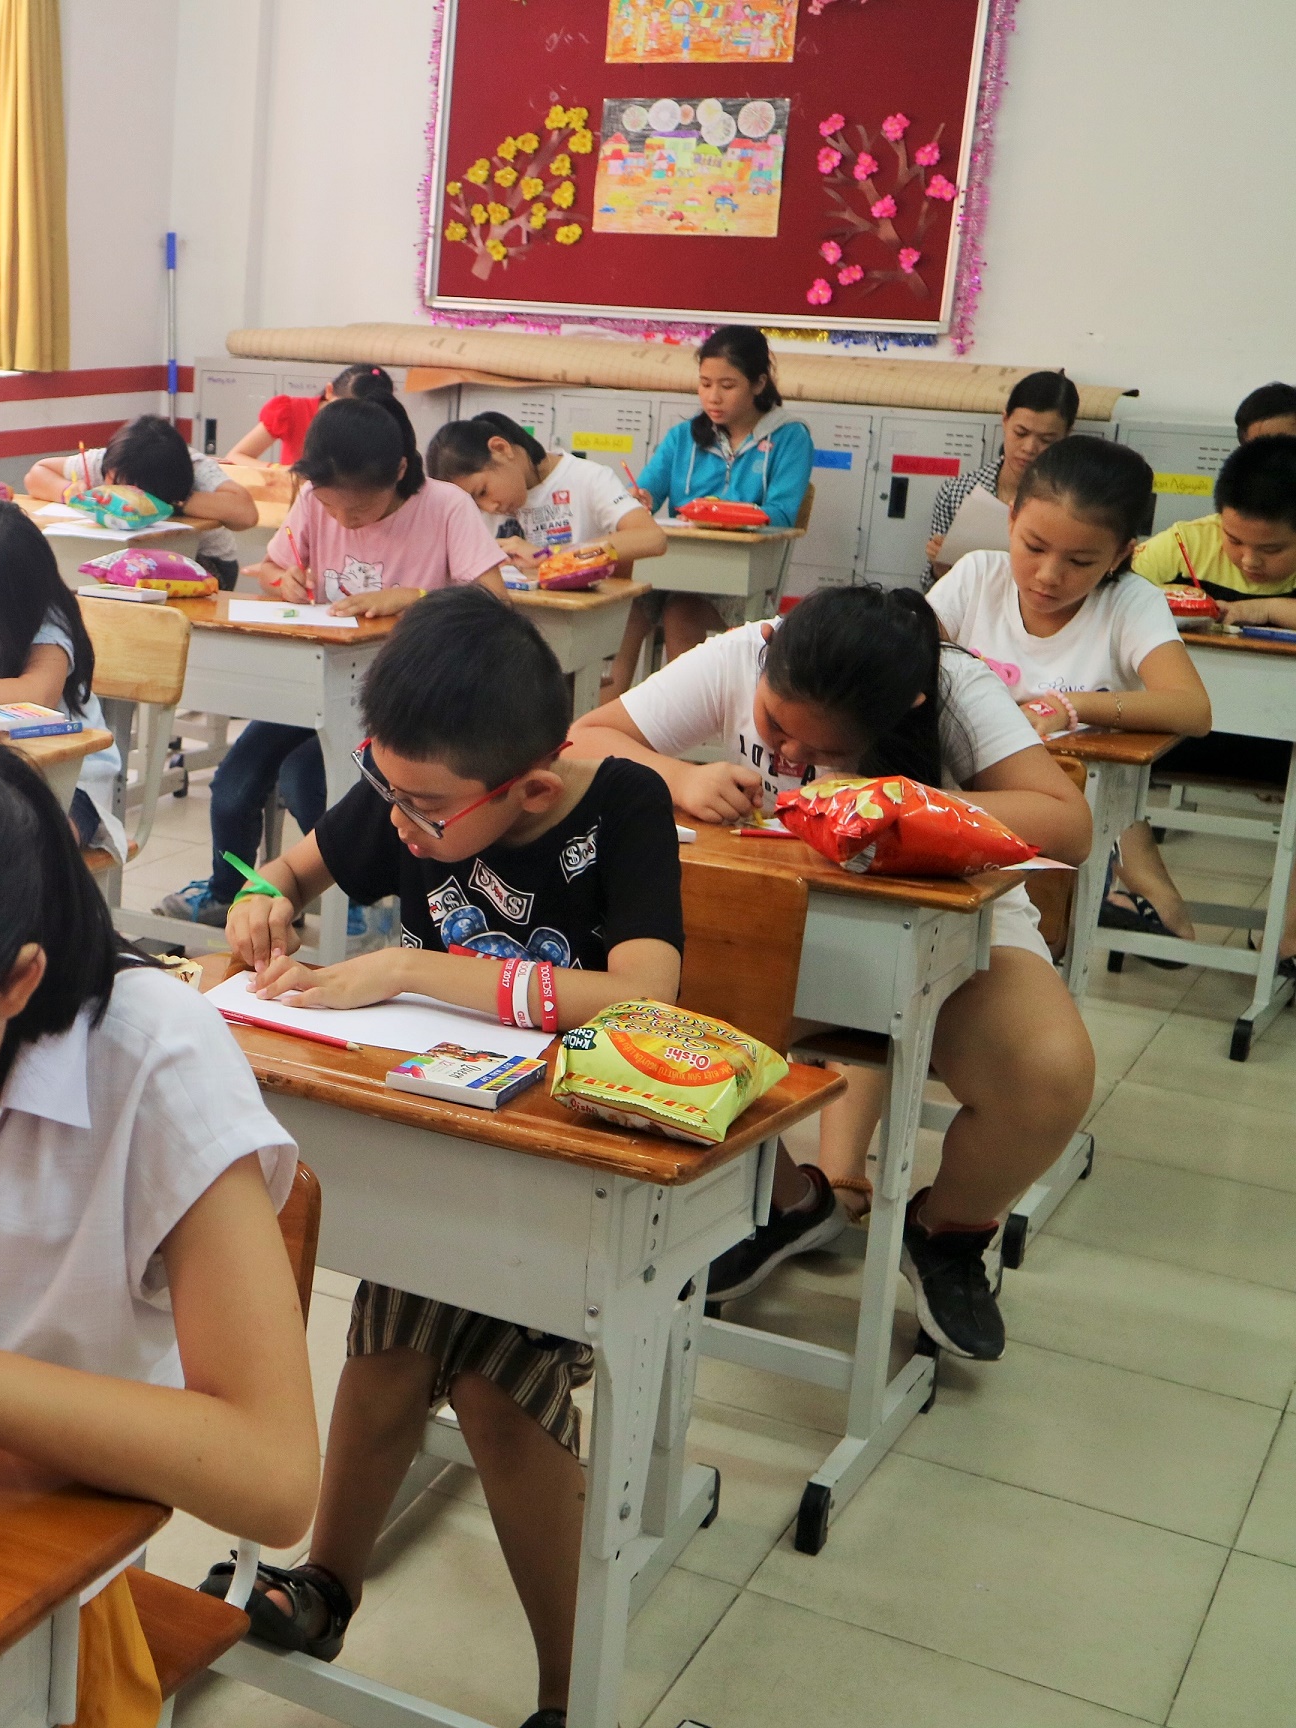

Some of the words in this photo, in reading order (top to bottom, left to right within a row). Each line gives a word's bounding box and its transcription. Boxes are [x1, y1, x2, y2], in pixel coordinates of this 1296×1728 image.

[532, 519, 570, 532] JEANS
[502, 970, 512, 988] 2017
[666, 1047, 711, 1070] Oishi
[570, 1098, 598, 1114] Oishi
